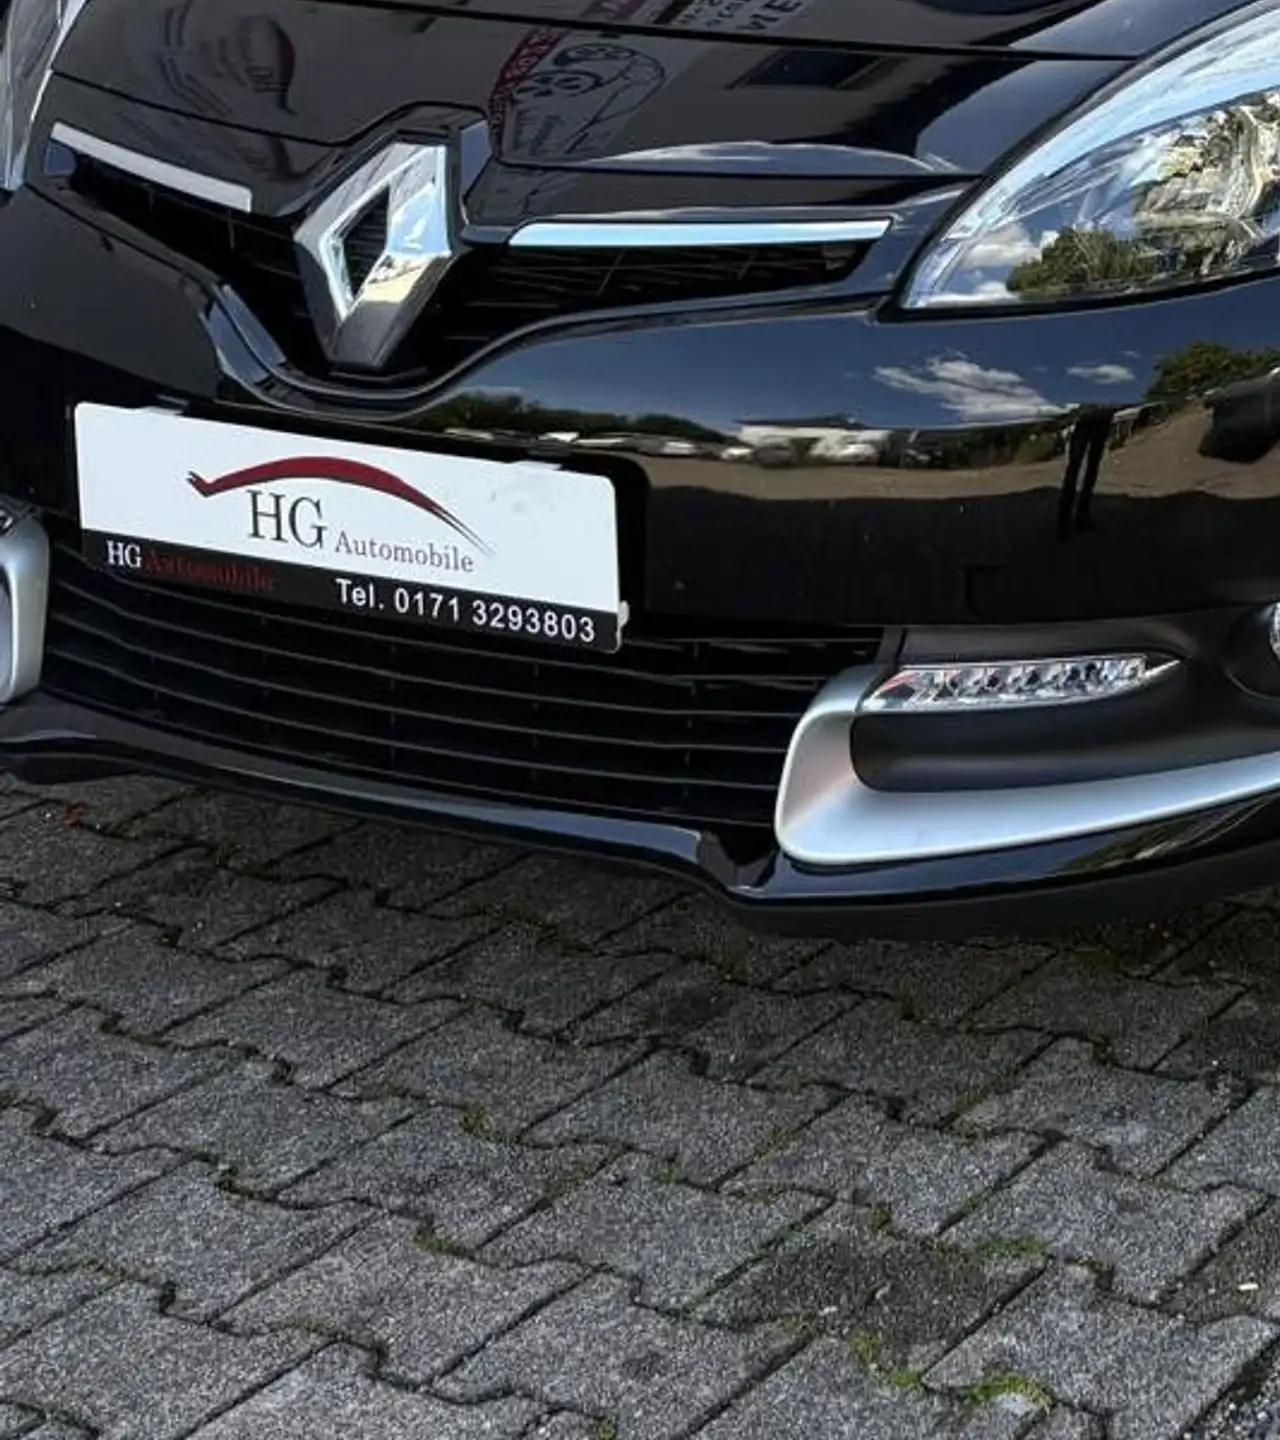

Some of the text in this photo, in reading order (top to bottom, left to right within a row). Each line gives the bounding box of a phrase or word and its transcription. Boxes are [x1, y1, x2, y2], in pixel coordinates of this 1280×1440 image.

[105, 539, 143, 569] HG
[246, 488, 475, 573] HG Automobile
[335, 578, 596, 643] Tel. 0171 3293803
